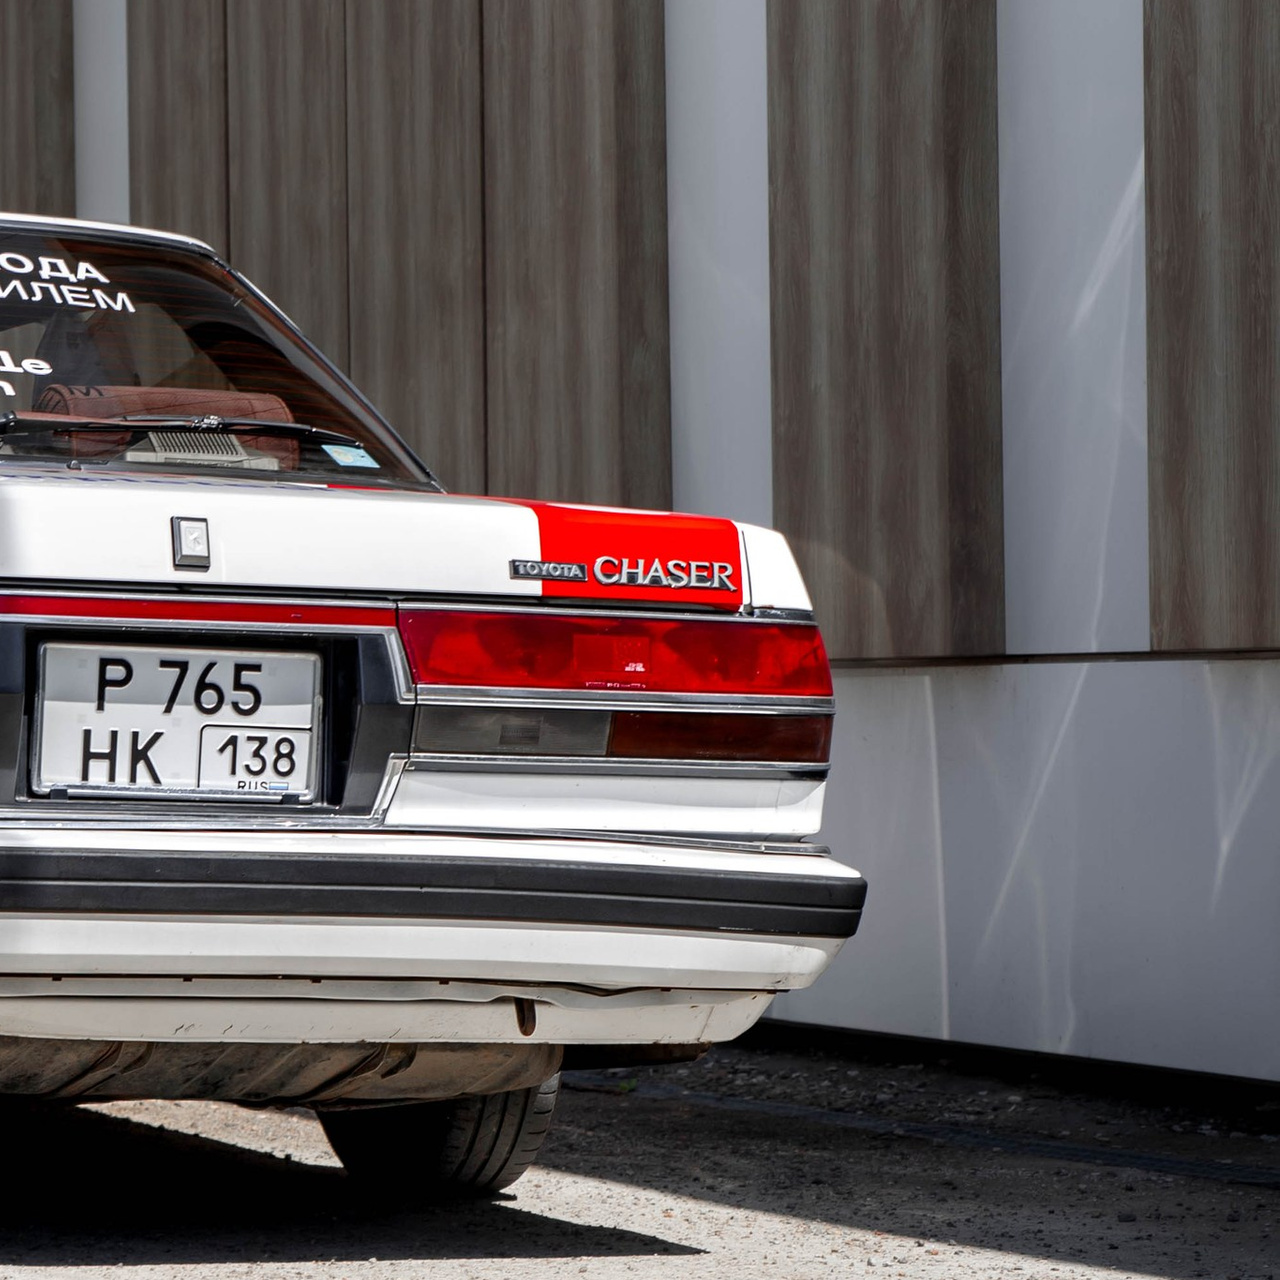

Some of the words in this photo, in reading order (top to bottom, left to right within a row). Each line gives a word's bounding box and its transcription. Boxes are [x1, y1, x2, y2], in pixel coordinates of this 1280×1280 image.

[514, 561, 584, 578] TOYOTA
[593, 556, 738, 592] CHASER
[159, 659, 263, 717] 765
[217, 735, 296, 777] 138
[237, 780, 268, 790] RUS
